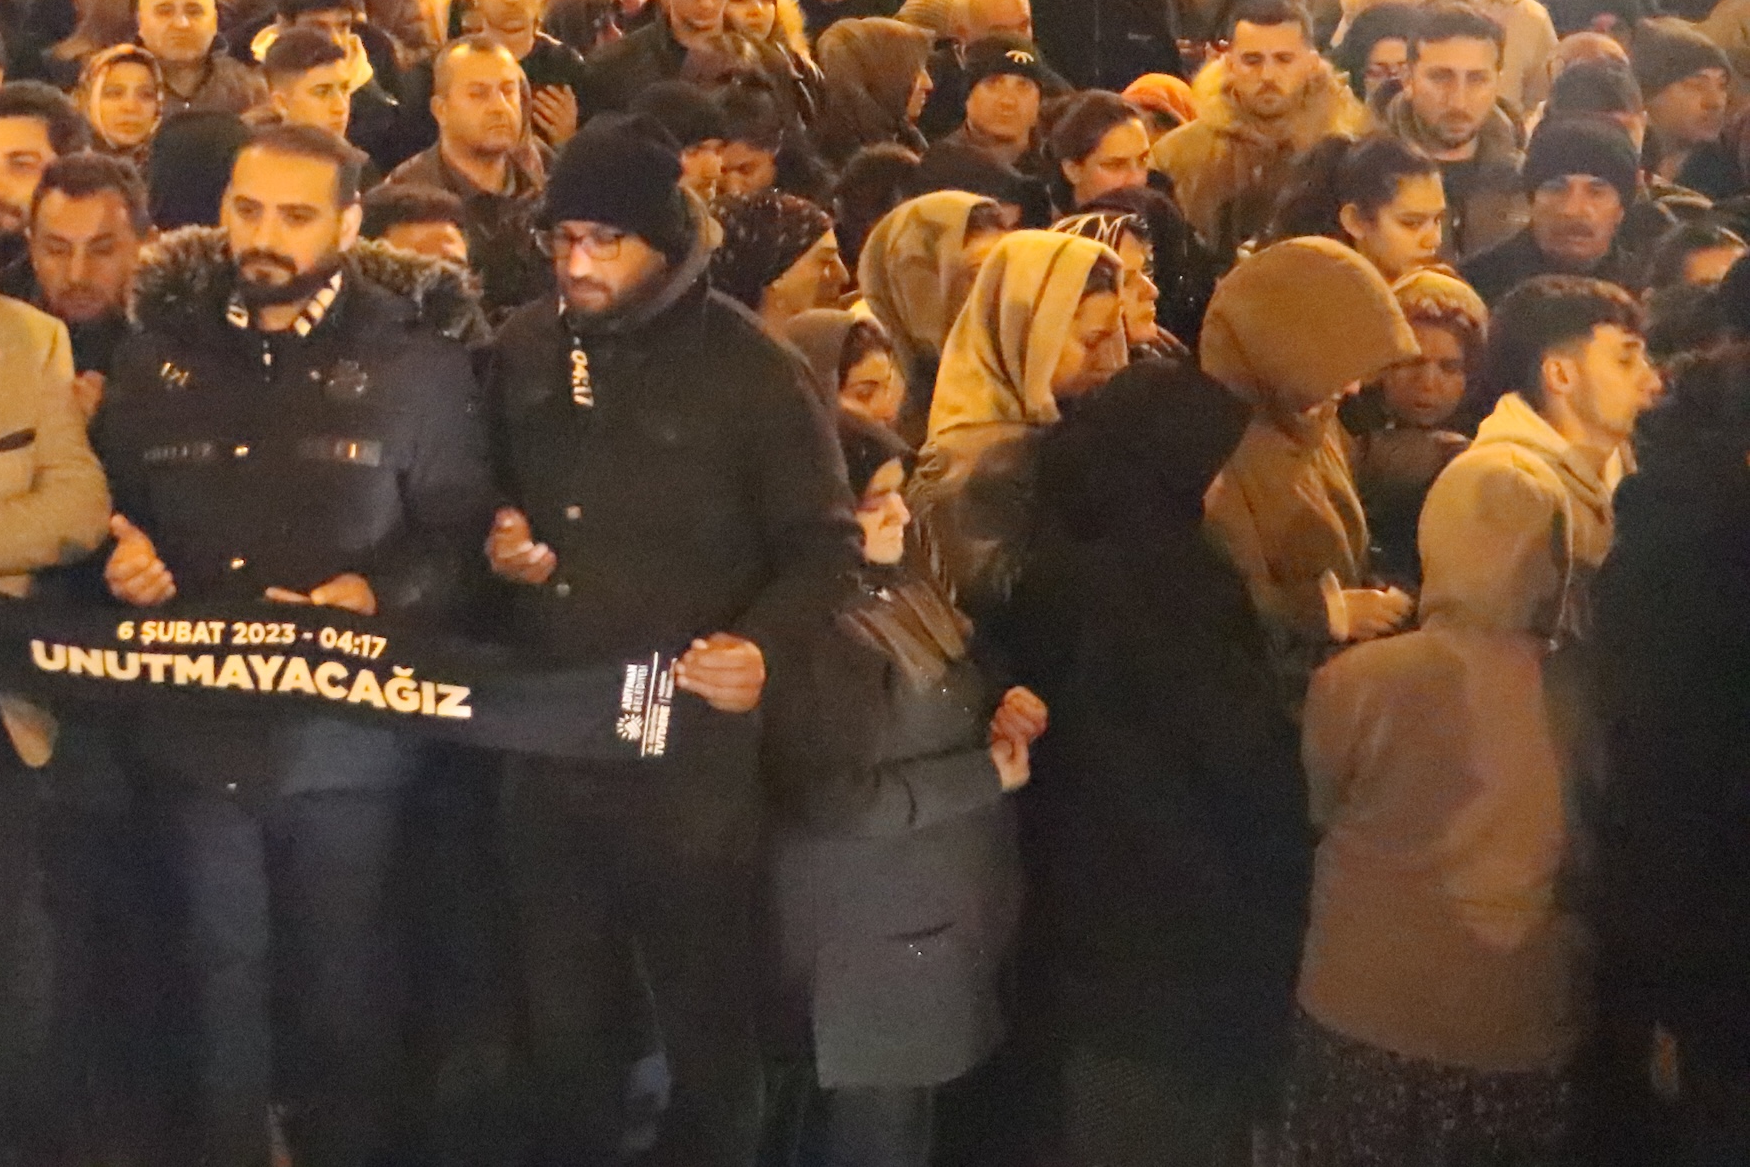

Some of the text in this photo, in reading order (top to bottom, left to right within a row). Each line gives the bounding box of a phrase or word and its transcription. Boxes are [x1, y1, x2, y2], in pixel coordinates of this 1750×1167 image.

[116, 621, 134, 641] 6
[140, 620, 225, 645] ŞUBAT
[232, 622, 296, 645] 2023
[319, 631, 388, 659] 04:17
[30, 639, 472, 719] UNUTMAYACAĞIZ
